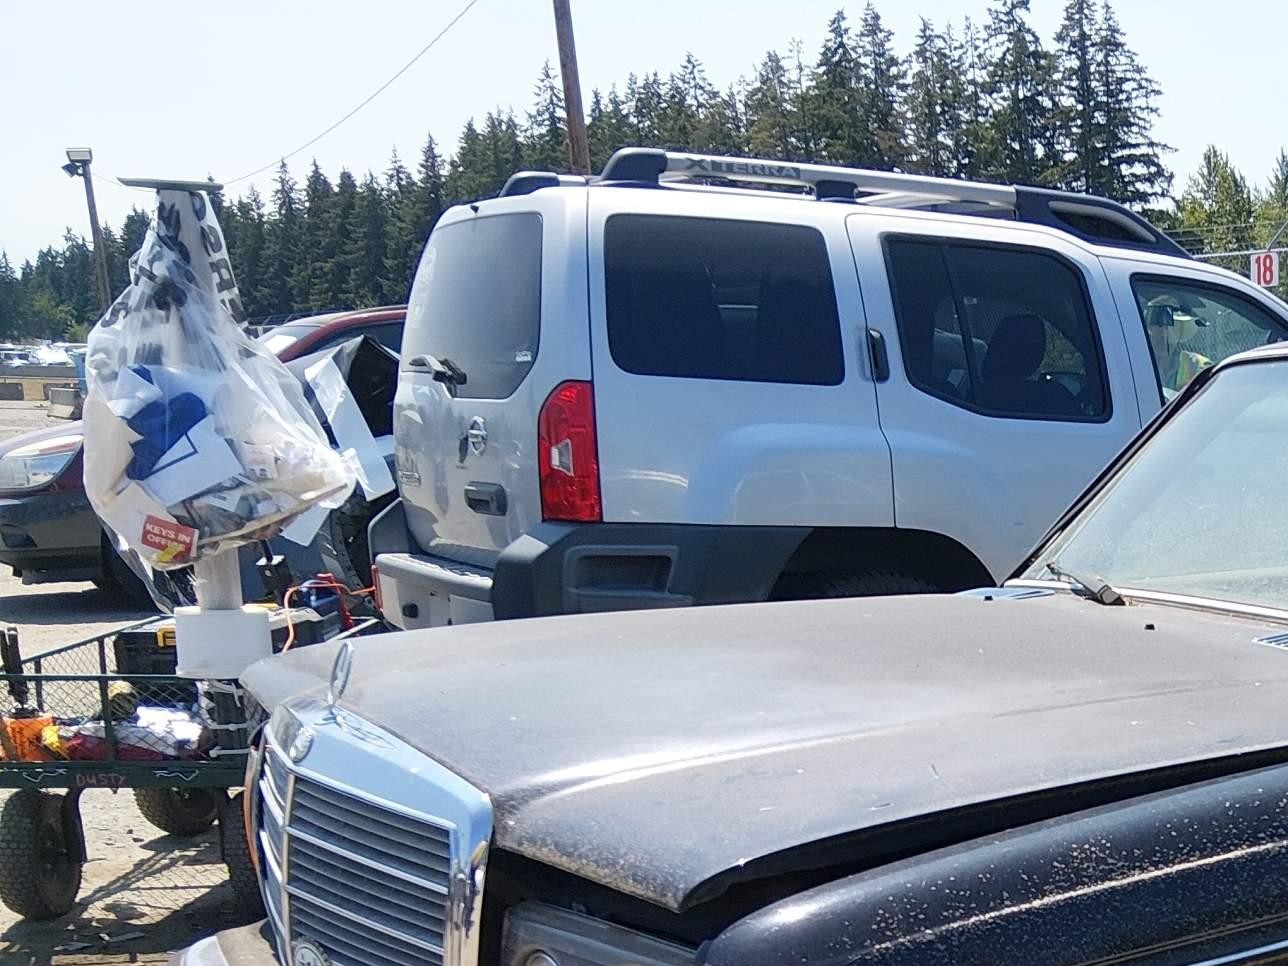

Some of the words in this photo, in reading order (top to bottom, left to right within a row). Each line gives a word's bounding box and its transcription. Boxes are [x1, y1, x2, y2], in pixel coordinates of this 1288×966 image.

[1255, 254, 1274, 286] 18
[145, 523, 177, 539] KEYS
[177, 533, 192, 544] IN
